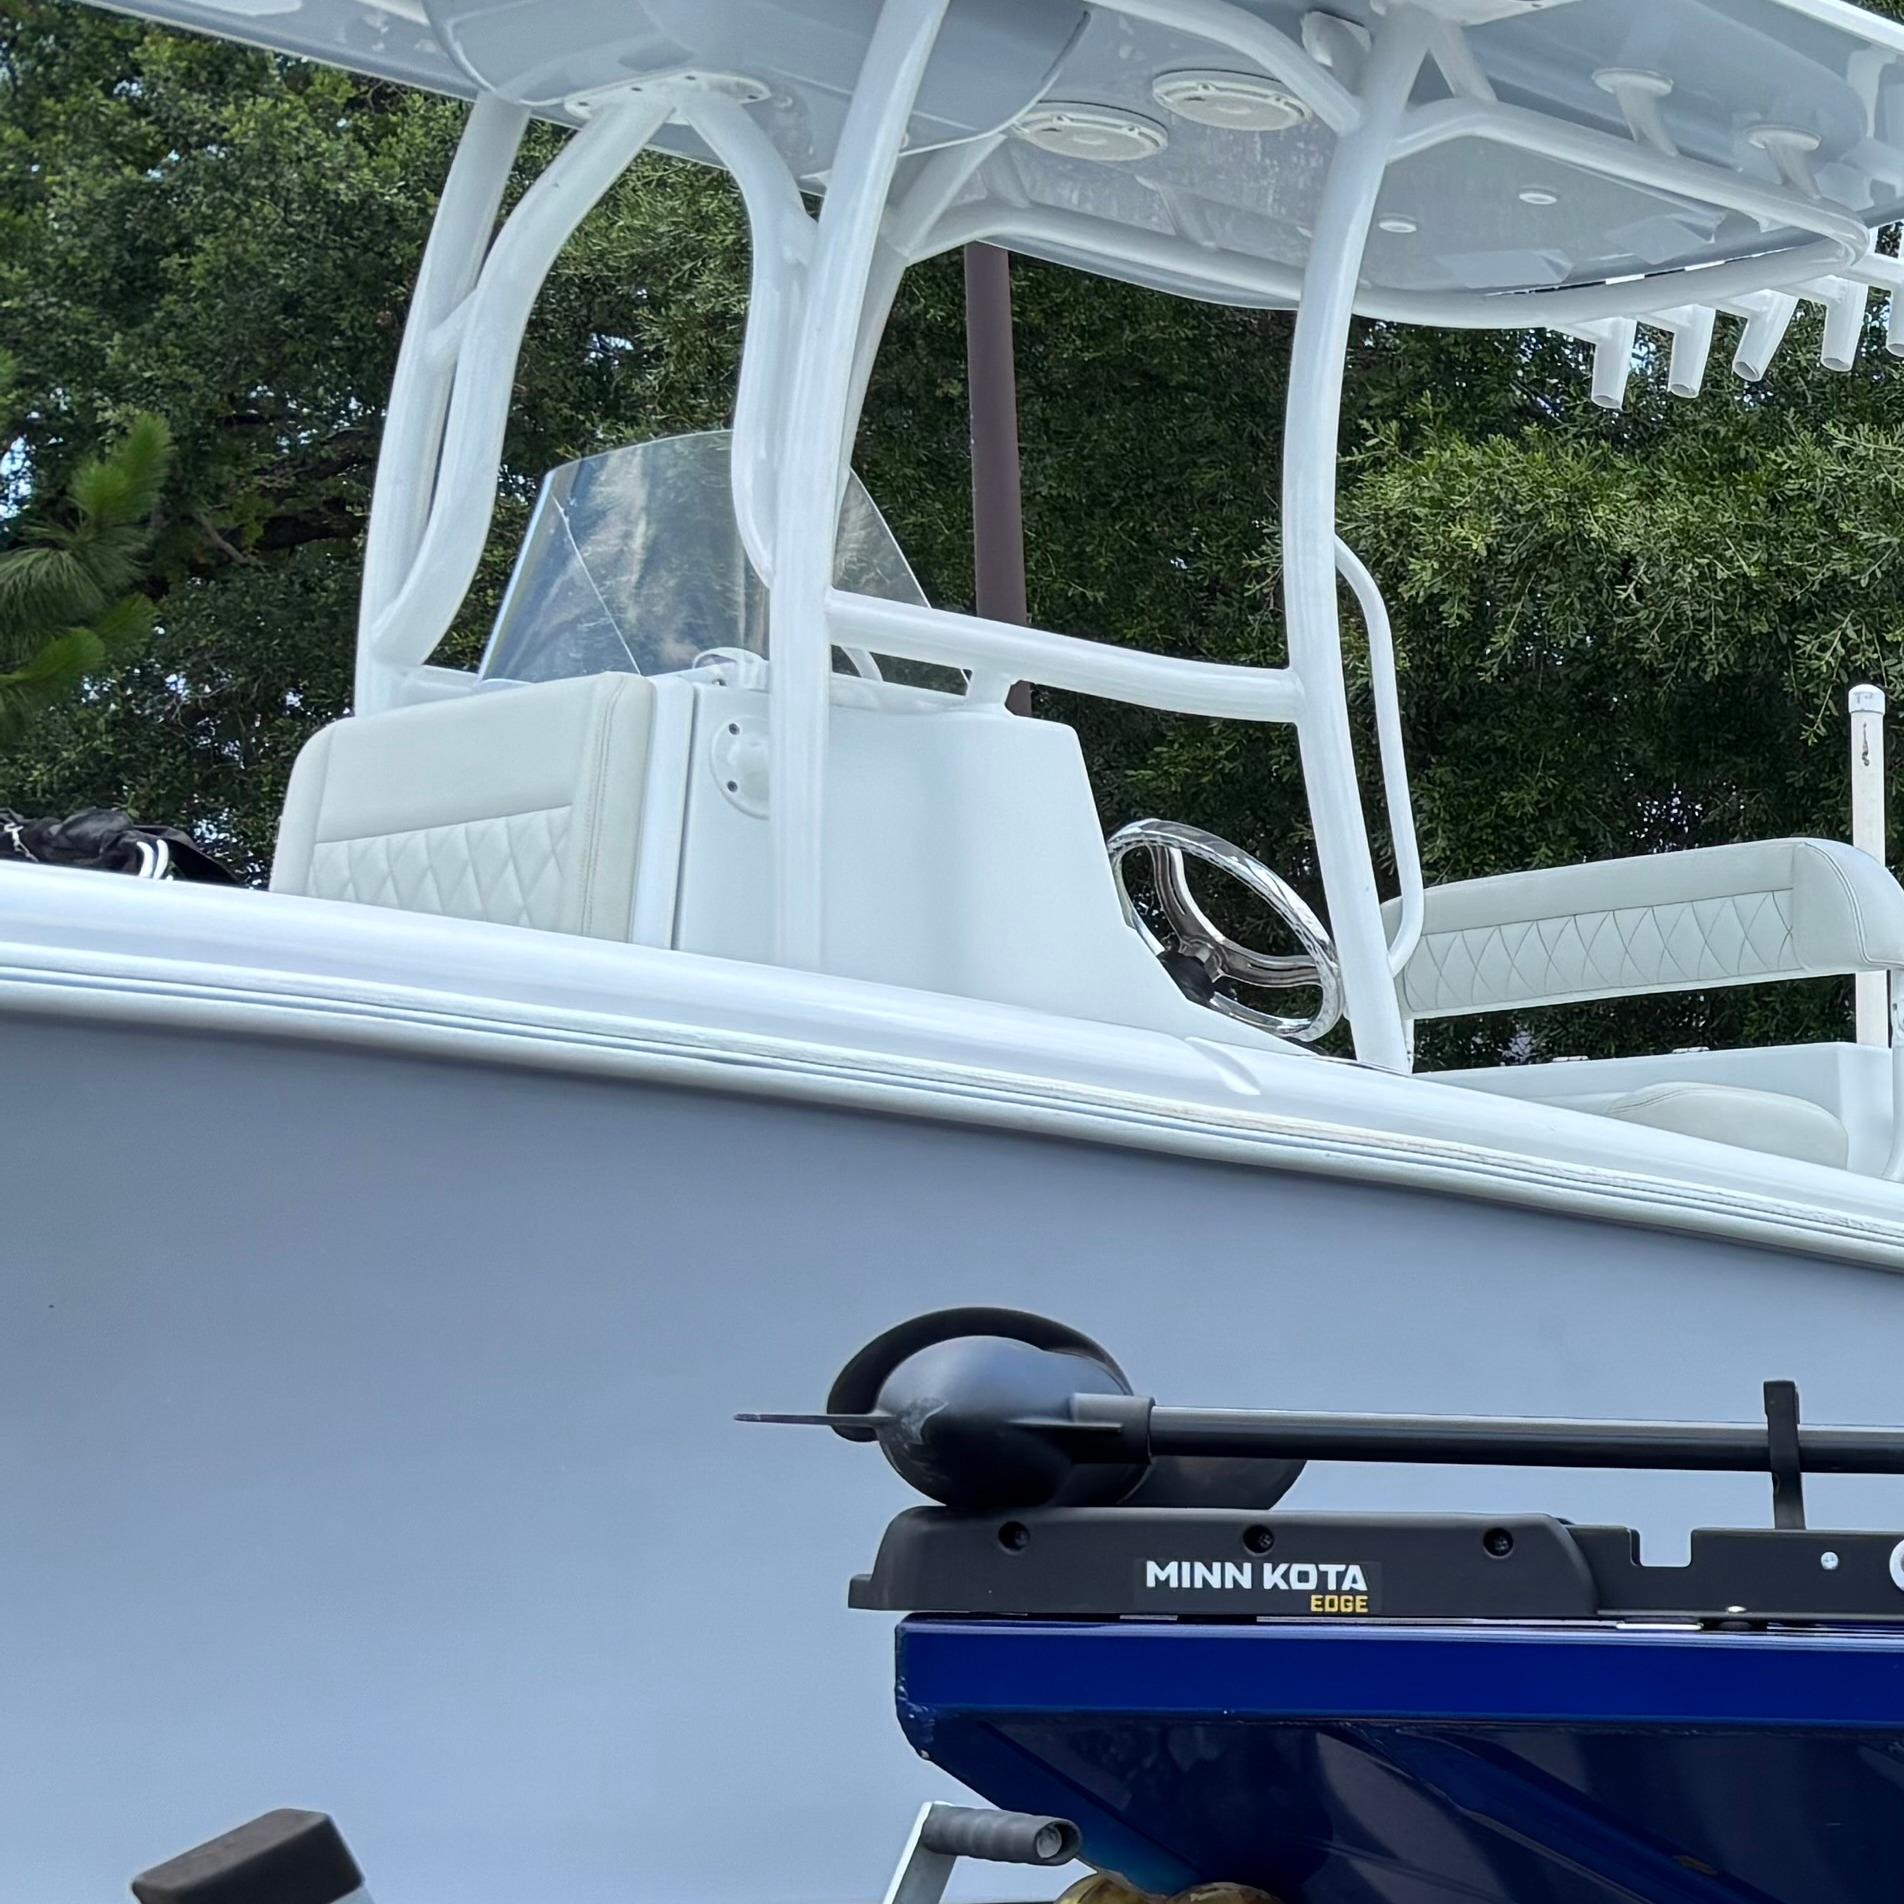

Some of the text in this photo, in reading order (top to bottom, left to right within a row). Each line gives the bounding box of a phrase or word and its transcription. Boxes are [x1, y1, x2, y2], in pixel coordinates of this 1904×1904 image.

[1146, 1560, 1368, 1591] MINN KOTA
[1311, 1595, 1368, 1613] EDGE
